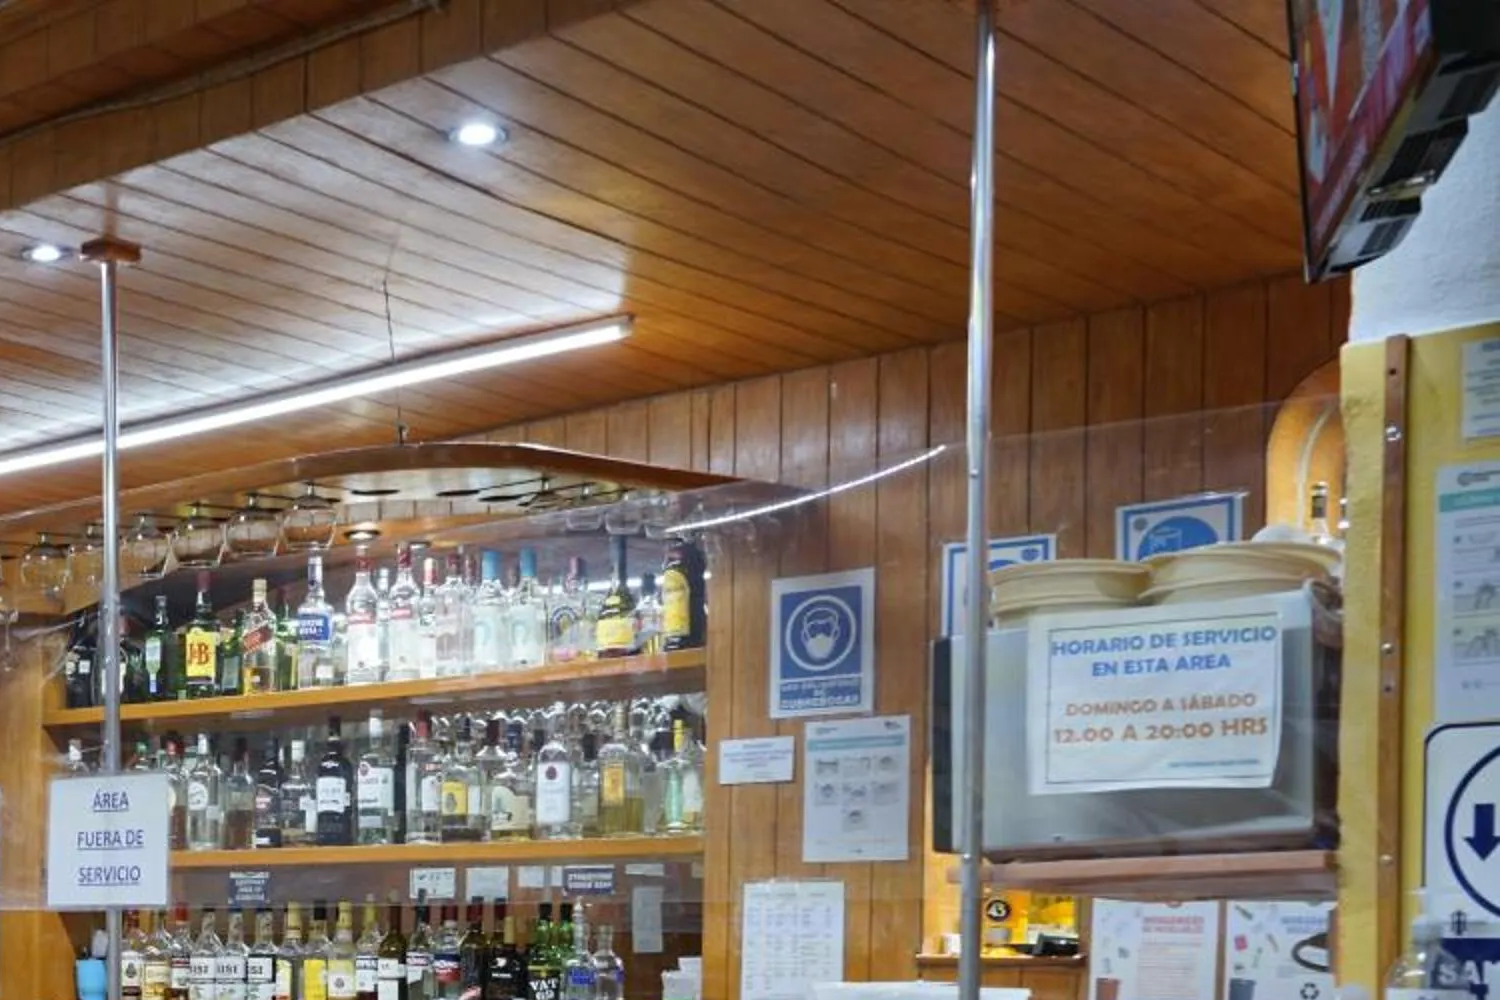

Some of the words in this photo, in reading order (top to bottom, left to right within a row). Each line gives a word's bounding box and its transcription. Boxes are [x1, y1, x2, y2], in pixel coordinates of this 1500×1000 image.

[1052, 634, 1145, 656] HORARIO
[1150, 632, 1179, 650] DE
[1182, 625, 1278, 647] SERVICIO
[1091, 660, 1118, 677] EN
[1123, 656, 1170, 676] ESTA
[1175, 653, 1232, 671] AREA
[1065, 698, 1158, 717] DOMINGO
[1161, 698, 1176, 712] A
[1122, 724, 1139, 742] A
[1145, 722, 1215, 741] 20:00
[1221, 716, 1268, 738] HRS
[92, 788, 130, 809] ÁREA
[77, 830, 122, 848] FUERA
[125, 829, 145, 846] DE
[78, 865, 141, 883] SERVICIO
